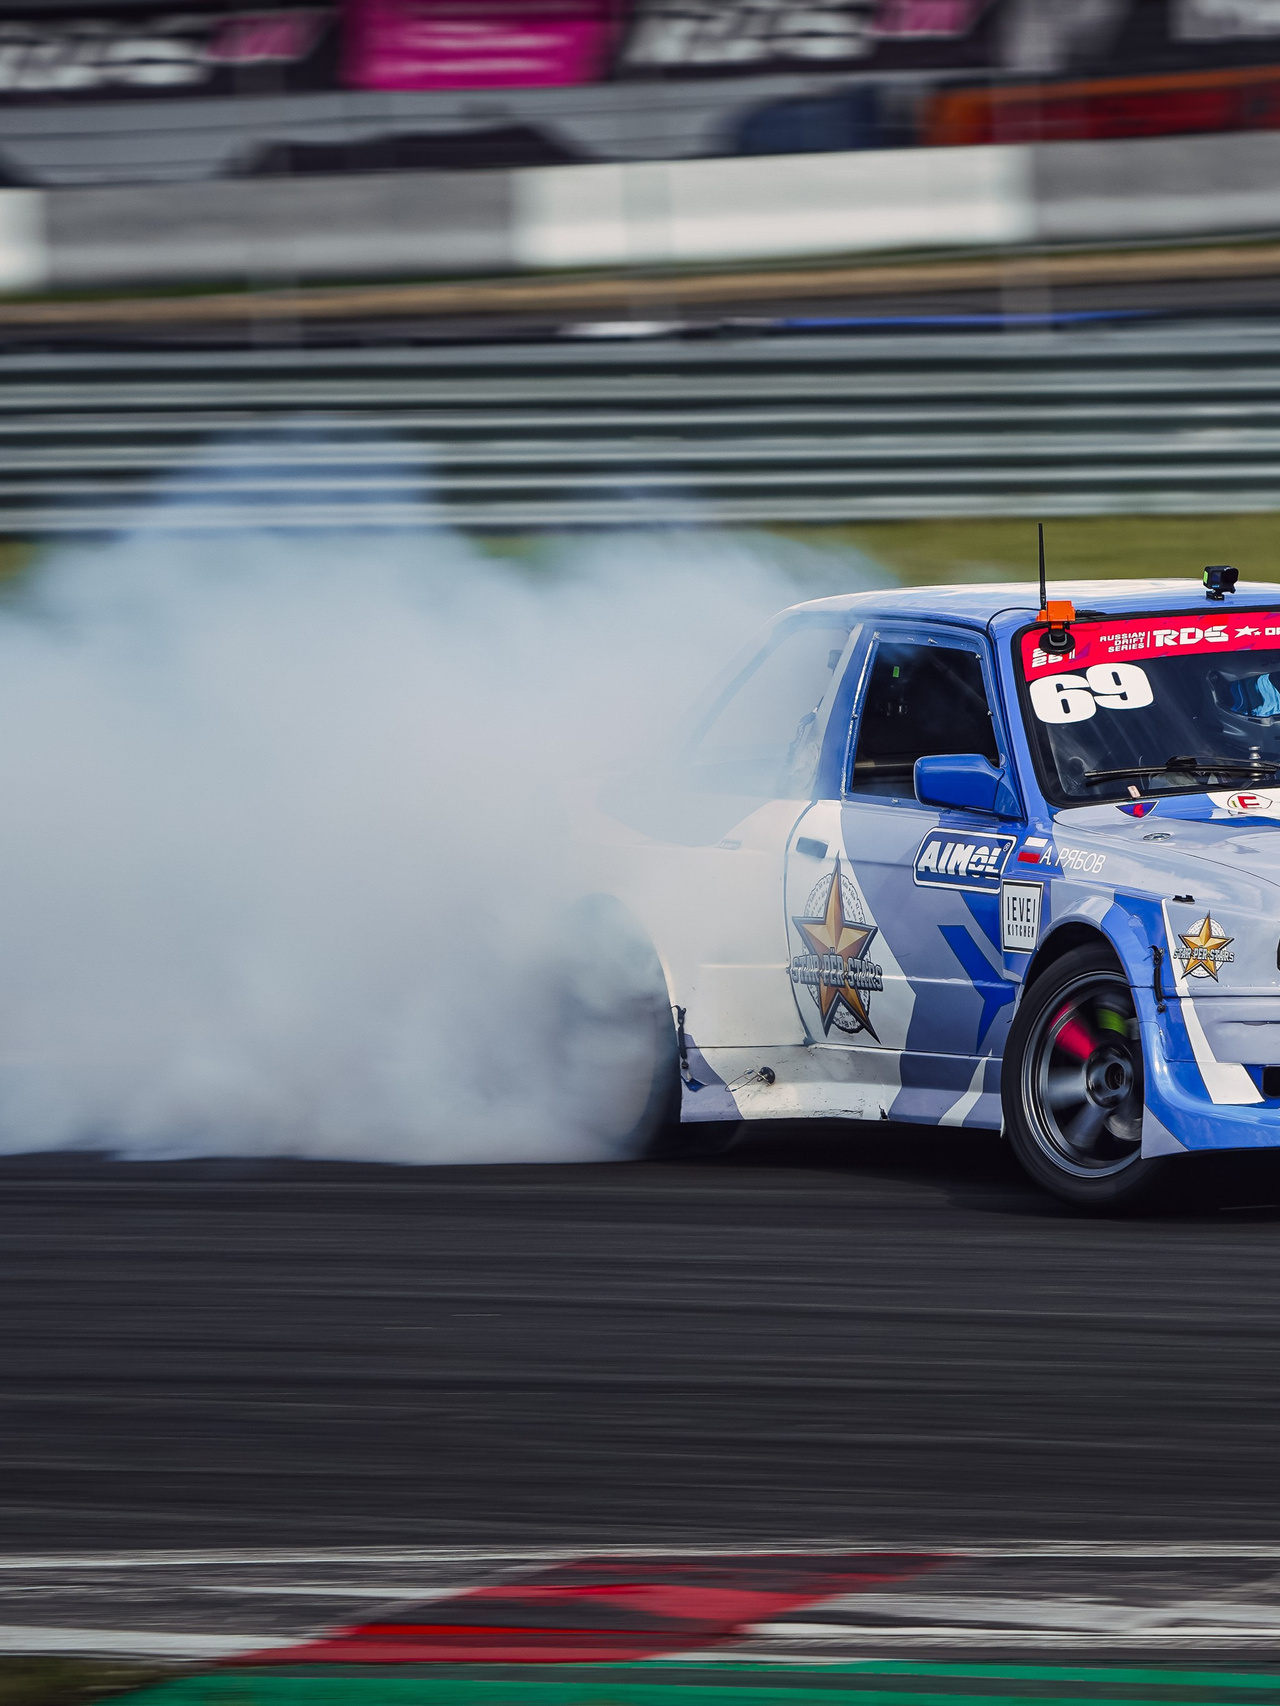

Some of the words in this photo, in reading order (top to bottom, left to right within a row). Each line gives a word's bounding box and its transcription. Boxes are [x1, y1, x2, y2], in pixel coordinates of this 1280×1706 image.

[1100, 631, 1146, 642] RUSSIAN
[1114, 637, 1145, 646] DRIFT
[1153, 626, 1229, 647] RDS
[1108, 642, 1144, 653] SERIES
[1029, 663, 1154, 724] 69
[917, 840, 1002, 880] AIMOL
[1039, 845, 1052, 866] А.
[1054, 847, 1107, 873] РЯБОВ
[1007, 923, 1035, 938] KITCHEN
